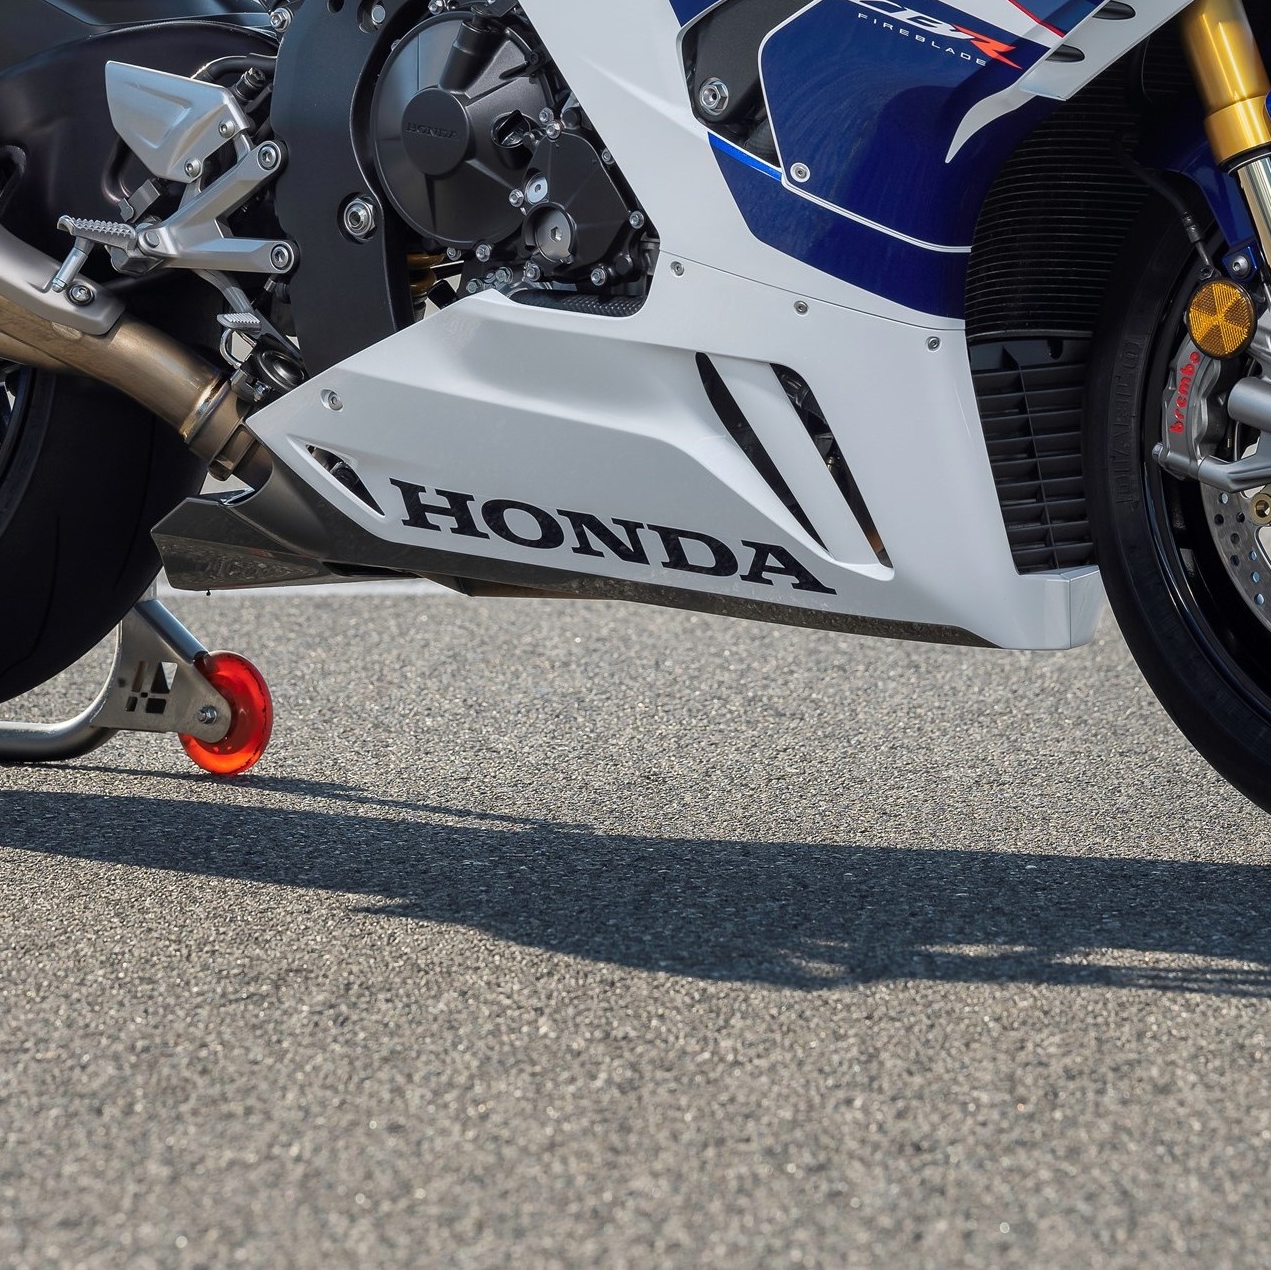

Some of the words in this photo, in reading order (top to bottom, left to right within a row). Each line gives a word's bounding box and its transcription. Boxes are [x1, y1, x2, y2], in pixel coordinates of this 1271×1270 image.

[857, 12, 987, 67] FIREBLADE
[405, 121, 458, 140] HONDA
[1168, 351, 1201, 434] brembo
[388, 476, 838, 596] HONDA
